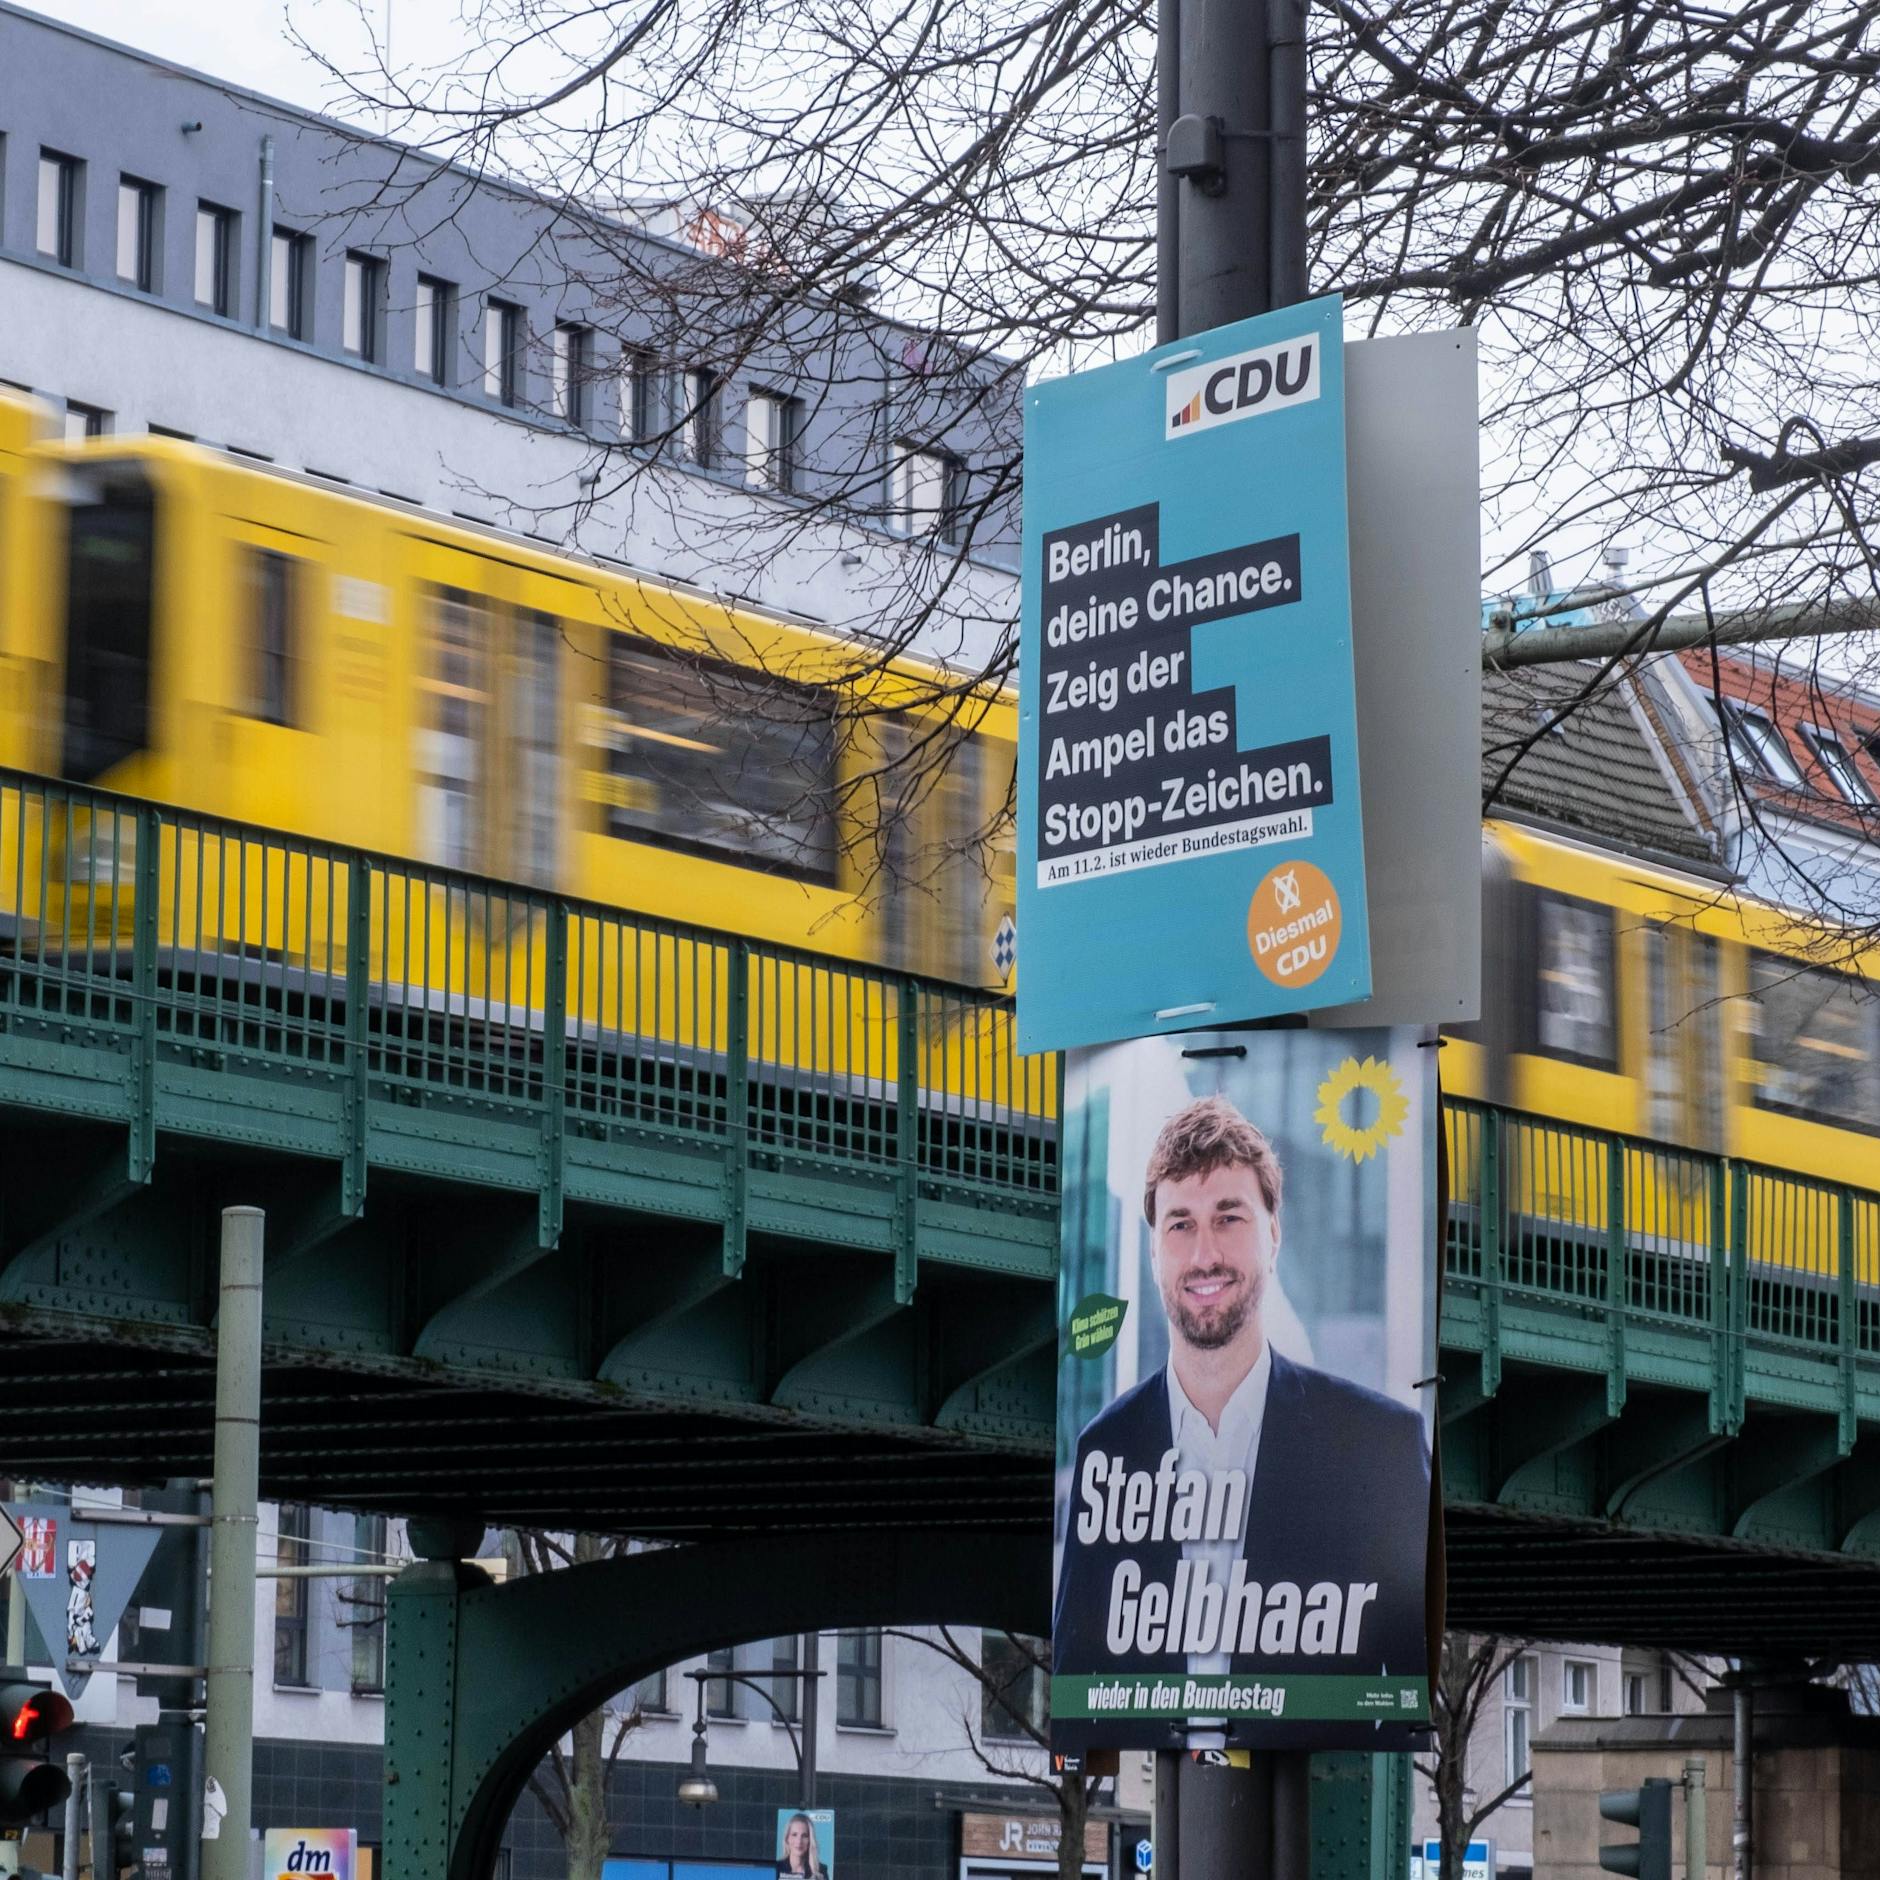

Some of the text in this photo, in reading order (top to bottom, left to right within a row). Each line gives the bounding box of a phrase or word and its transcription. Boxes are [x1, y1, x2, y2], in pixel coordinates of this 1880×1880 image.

[1204, 344, 1312, 415] CDU
[1048, 522, 1151, 583] Berlin,
[1046, 560, 1293, 648] deine Chance.
[1046, 650, 1185, 714] Zeig der
[1045, 708, 1229, 780] Ampel das
[1044, 758, 1323, 846] Stopp-Zeichen.
[1048, 815, 1308, 880] Am 11.2. ist wieder Bundestagswahl.
[1255, 899, 1334, 955] Diesmal
[1276, 934, 1327, 976] CDU
[1077, 1448, 1248, 1545] Stefan
[1106, 1559, 1379, 1656] Gelbhaar
[1088, 1680, 1286, 1717] wieder in den Bundestag
[287, 1841, 331, 1871] dm
[999, 1821, 1024, 1852] JR
